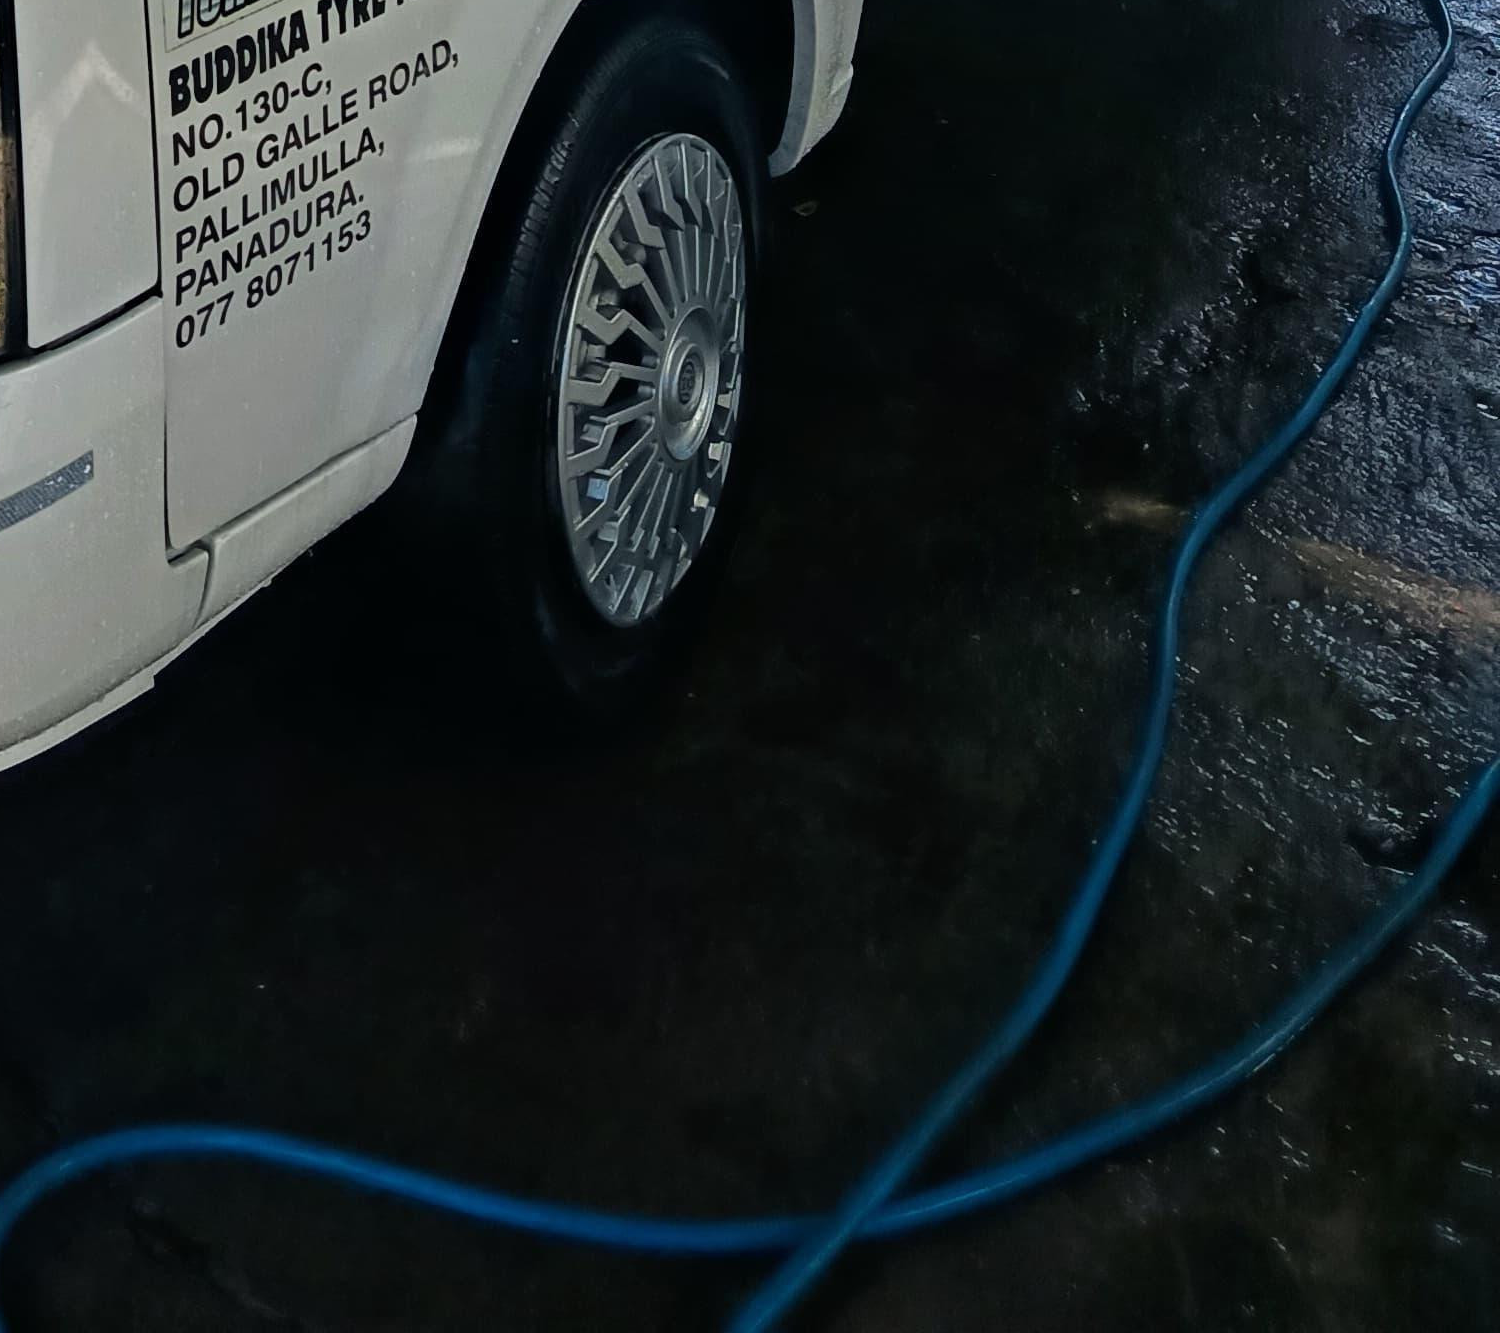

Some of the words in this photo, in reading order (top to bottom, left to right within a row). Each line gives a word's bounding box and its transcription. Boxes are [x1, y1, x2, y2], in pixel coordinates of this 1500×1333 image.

[168, 8, 310, 117] BUDDIKA
[172, 62, 333, 166] NO.130-C,
[172, 151, 246, 213] OLD
[255, 88, 360, 171] GALLE
[368, 38, 460, 110] ROAD,
[175, 127, 387, 263] PALLIMULLA,
[175, 181, 366, 306] PANADURA.
[174, 292, 236, 349] 077
[245, 209, 373, 311] 8071153
